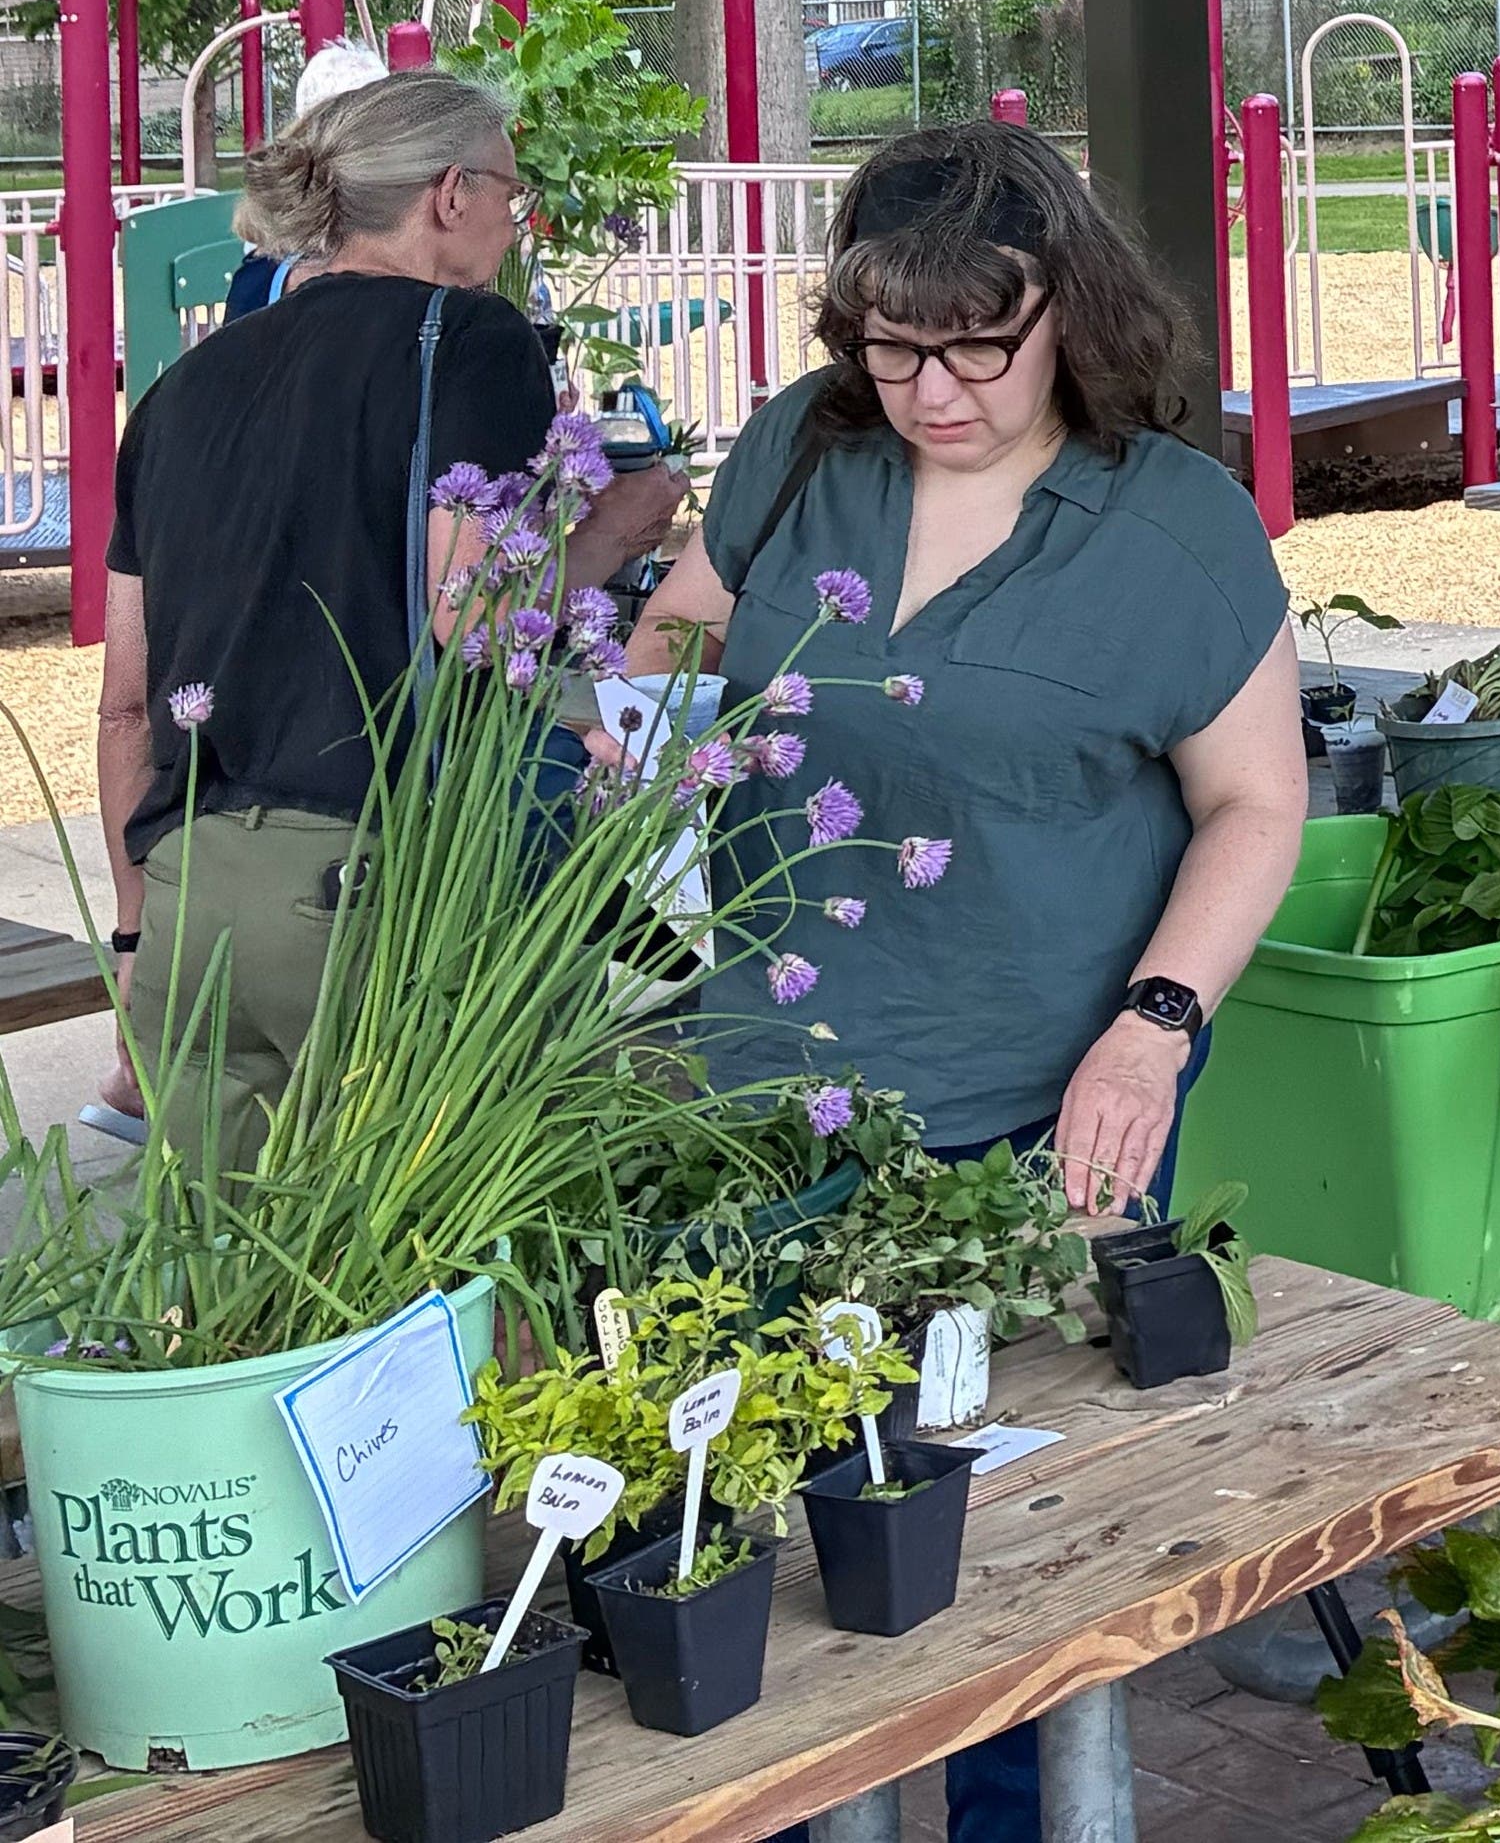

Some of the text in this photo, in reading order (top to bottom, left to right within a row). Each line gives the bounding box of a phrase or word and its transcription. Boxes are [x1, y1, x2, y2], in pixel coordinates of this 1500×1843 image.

[337, 1418, 398, 1483] Chives
[51, 1489, 253, 1565] Plants
[74, 1548, 346, 1641] that Work
